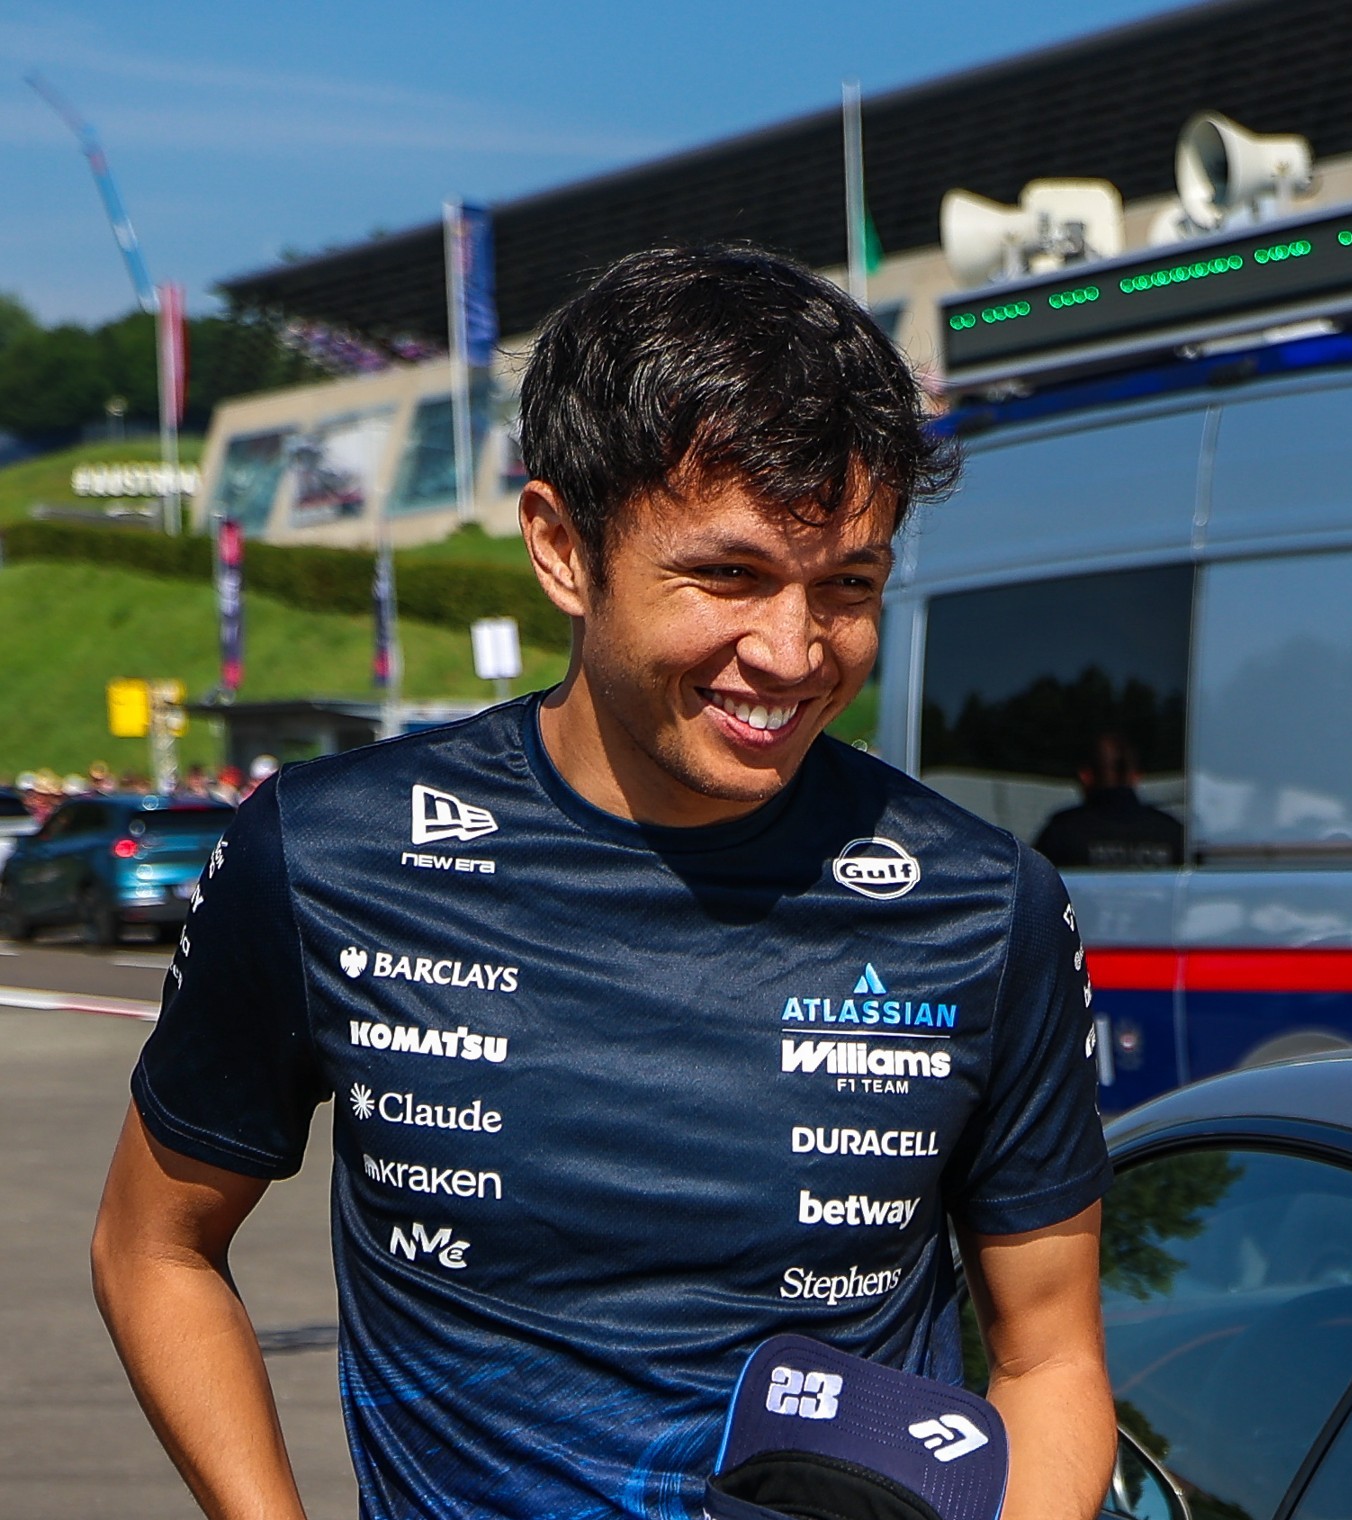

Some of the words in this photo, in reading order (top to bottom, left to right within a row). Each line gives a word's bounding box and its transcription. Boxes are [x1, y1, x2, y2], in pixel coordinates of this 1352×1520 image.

[839, 862, 913, 881] Gulf
[373, 952, 519, 992] BARCLAYS
[781, 998, 957, 1028] ATLASSIAN
[350, 1020, 508, 1063] KOMATSU
[781, 1039, 951, 1078] Williams
[837, 1078, 855, 1093] F1
[862, 1079, 909, 1094] TEAM
[378, 1092, 503, 1133] Claude
[791, 1126, 939, 1157] DURACELL
[380, 1159, 503, 1200] kraken
[798, 1190, 921, 1230] betway
[779, 1265, 902, 1305] Stephens
[765, 1365, 843, 1420] 23
